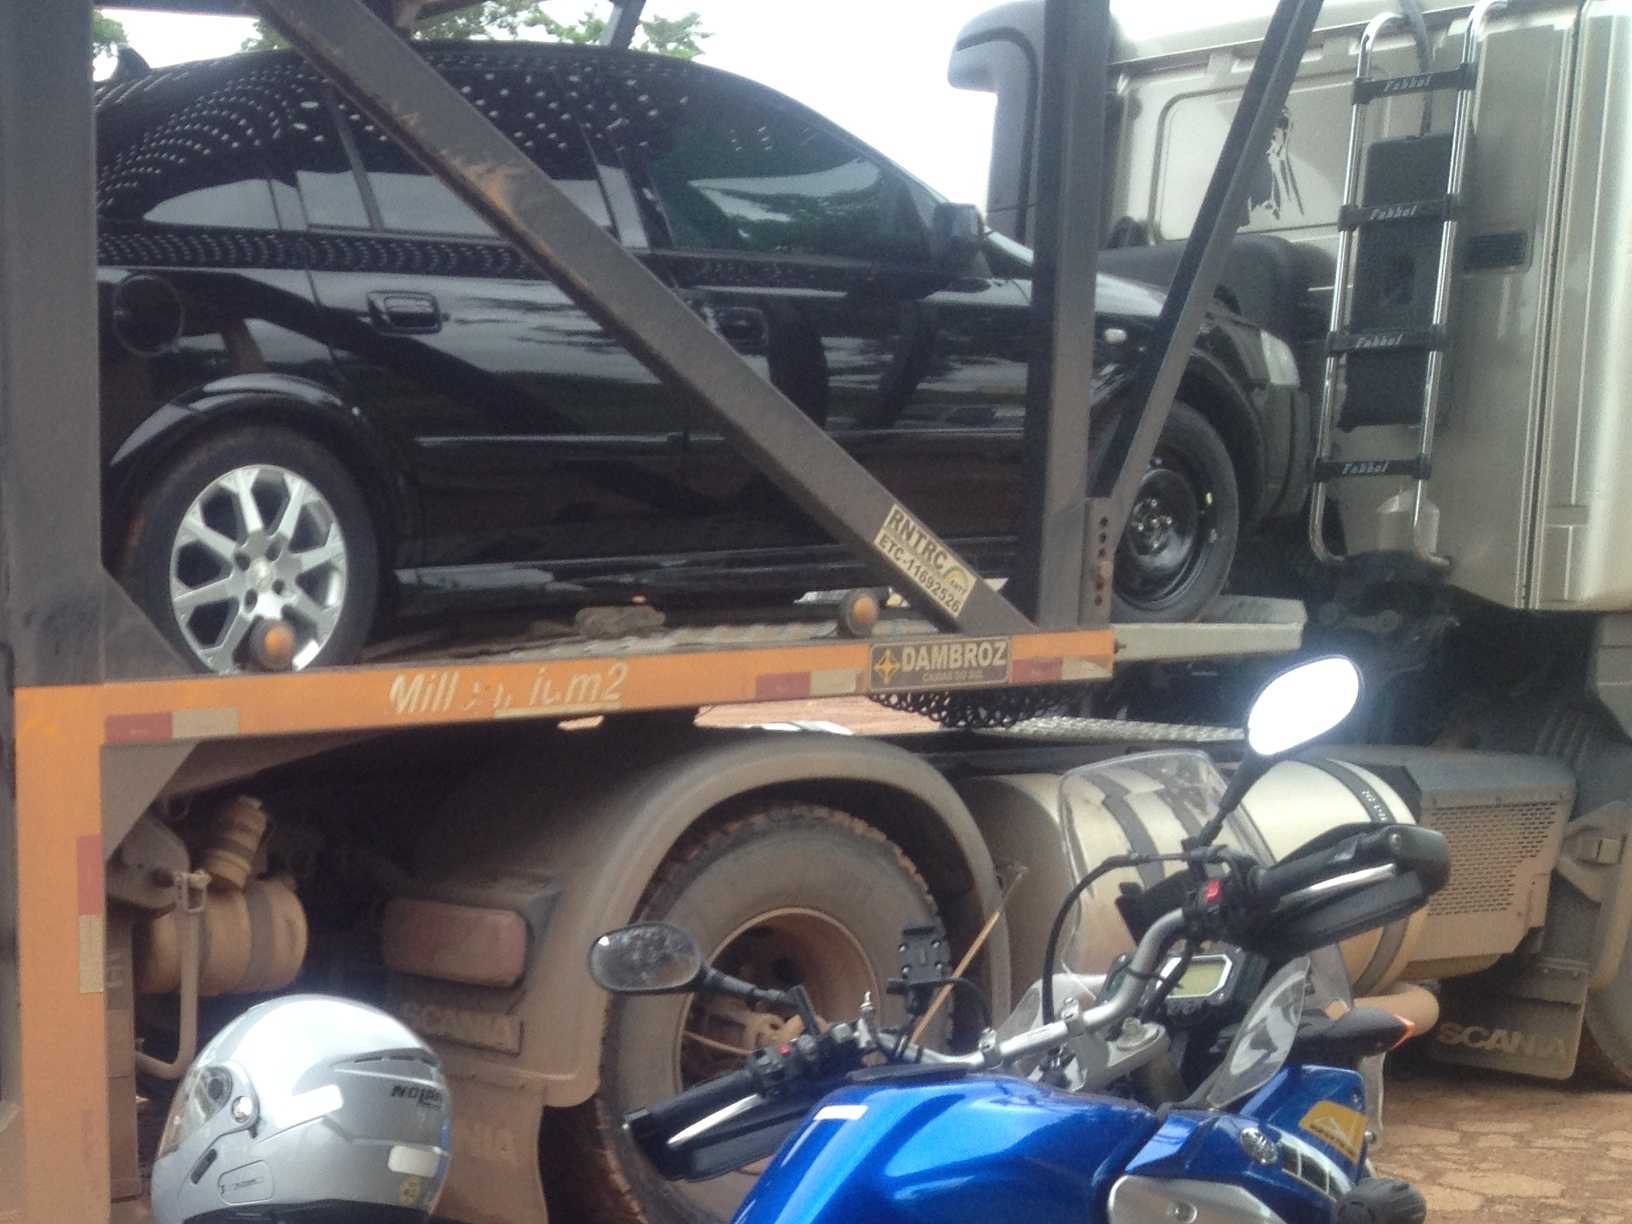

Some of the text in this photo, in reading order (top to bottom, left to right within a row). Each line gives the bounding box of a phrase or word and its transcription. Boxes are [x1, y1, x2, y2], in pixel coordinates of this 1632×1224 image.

[886, 508, 949, 571] RNTRC
[879, 533, 963, 615] ETC-11692526
[901, 641, 1008, 672] DAMBROZ
